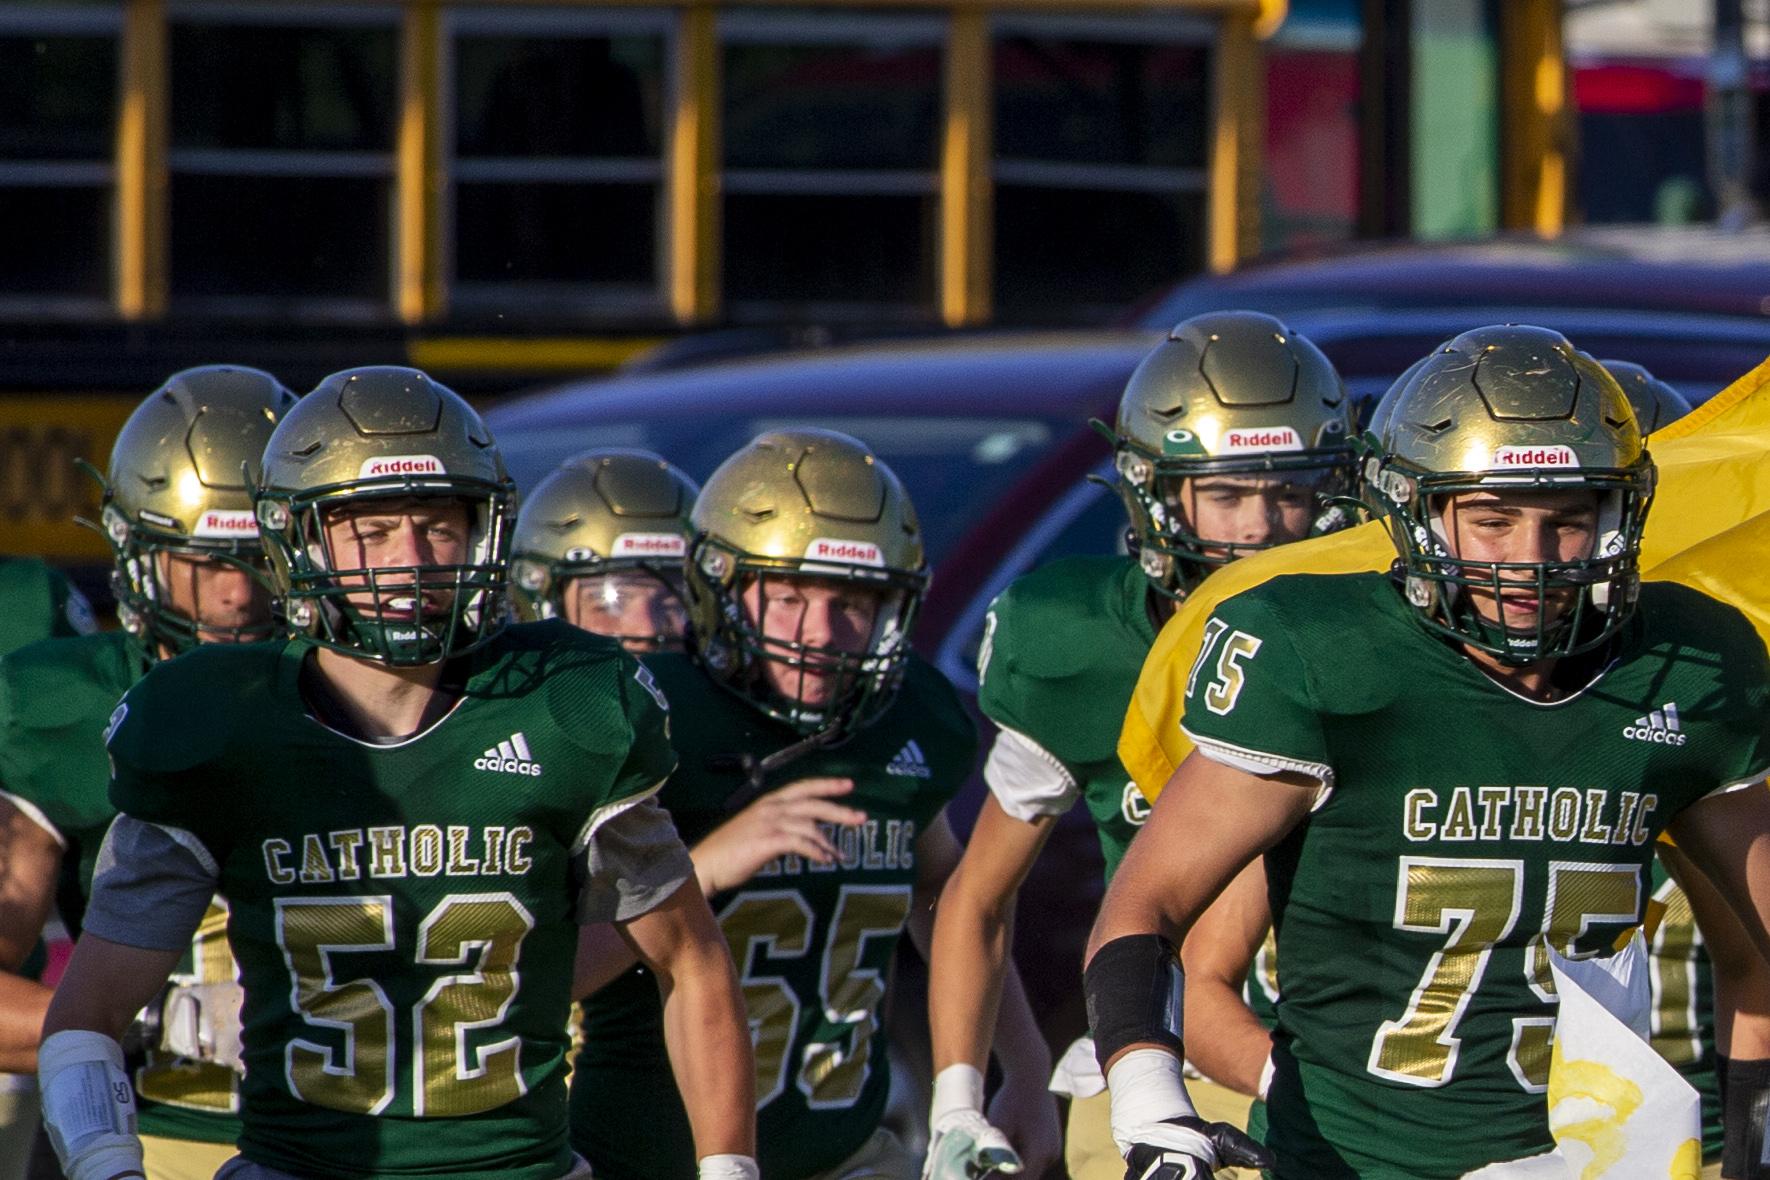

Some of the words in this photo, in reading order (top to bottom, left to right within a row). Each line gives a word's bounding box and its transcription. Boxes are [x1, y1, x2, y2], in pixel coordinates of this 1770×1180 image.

[1229, 433, 1293, 447] Riddell
[1502, 451, 1570, 465] Riddell
[371, 461, 436, 474] Riddell
[207, 515, 258, 530] Ridde
[624, 539, 681, 550] Riddell
[818, 544, 876, 560] Riddell
[1622, 725, 1687, 746] adidas
[474, 757, 541, 777] adidas
[1403, 787, 1658, 846] CATHOLIC
[262, 824, 534, 884] CATHOLIC
[272, 892, 535, 1117] 52
[715, 884, 914, 1110] 65
